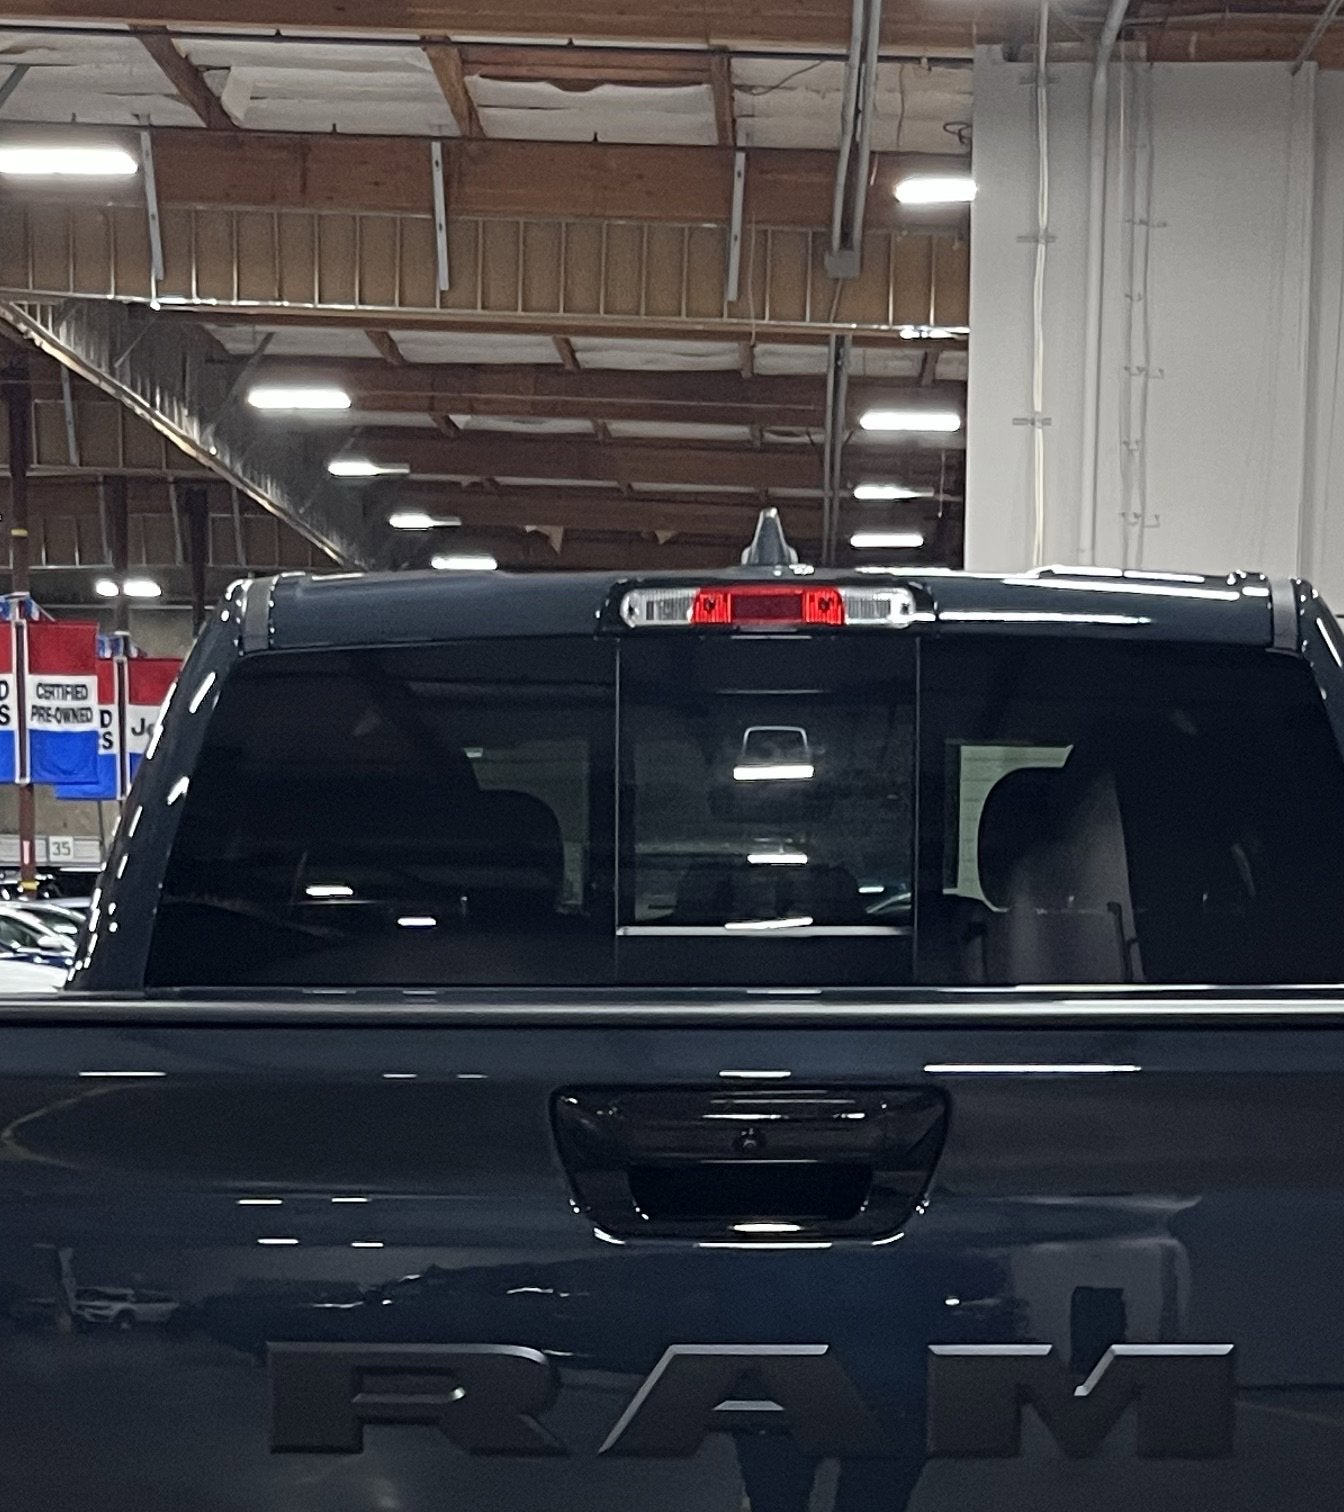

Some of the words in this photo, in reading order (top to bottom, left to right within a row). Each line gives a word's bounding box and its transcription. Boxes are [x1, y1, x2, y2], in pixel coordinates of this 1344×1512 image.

[36, 683, 88, 701] CERTIFIED
[31, 704, 93, 725] PRE-OWNED
[51, 840, 71, 857] 35
[265, 1341, 1236, 1459] RAM
